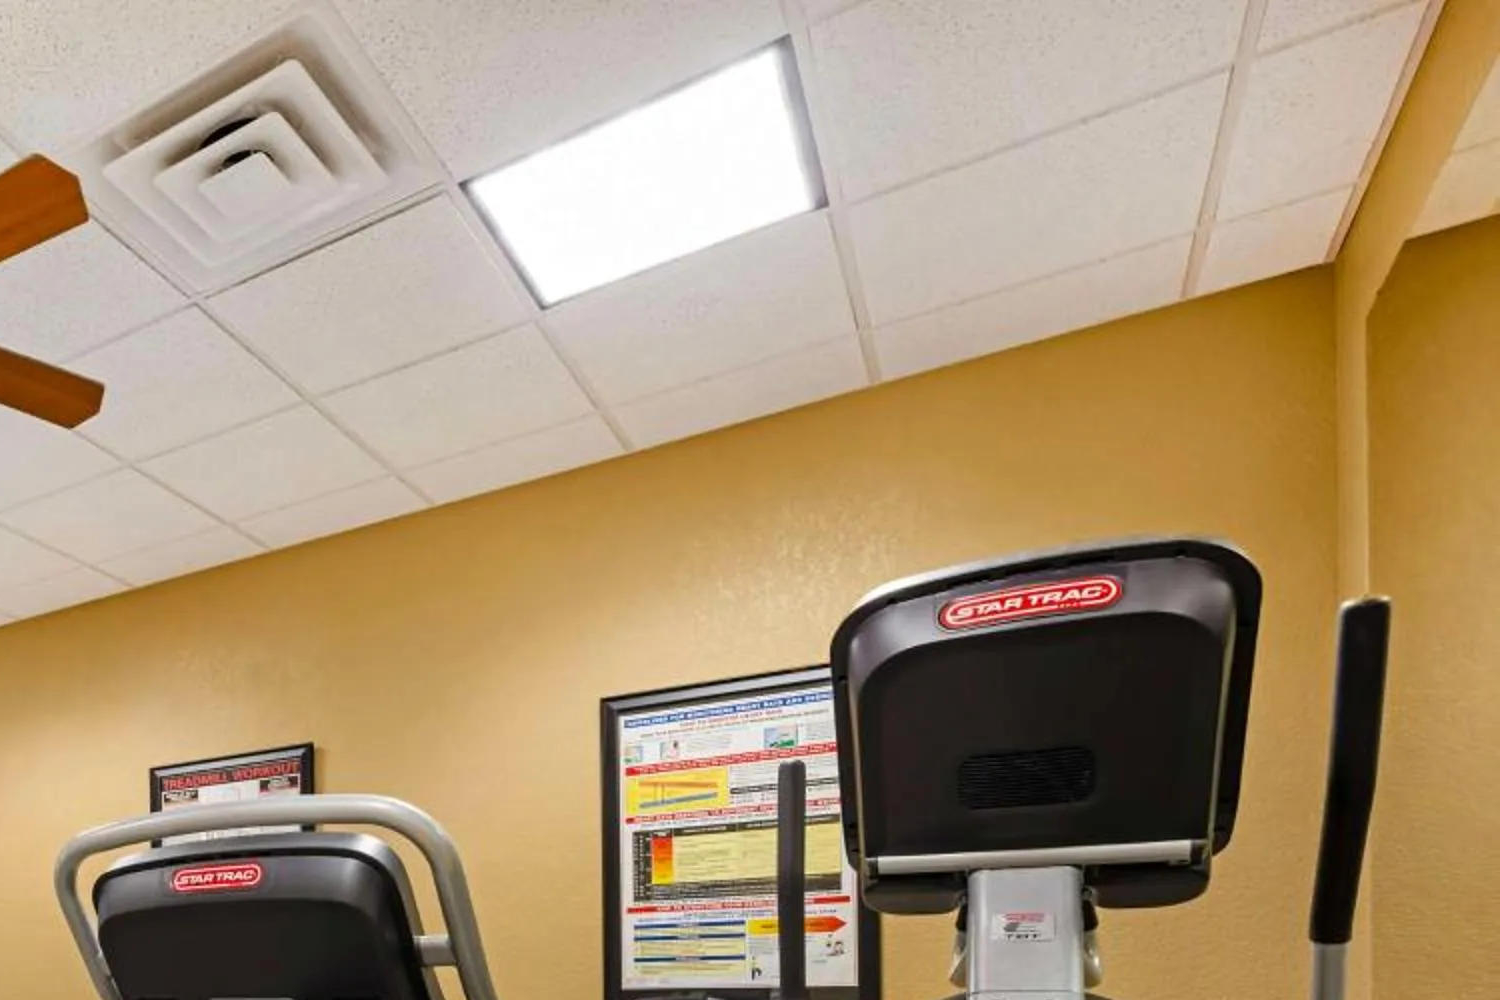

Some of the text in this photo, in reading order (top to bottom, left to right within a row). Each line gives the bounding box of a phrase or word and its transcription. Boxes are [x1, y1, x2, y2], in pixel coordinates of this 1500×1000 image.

[956, 595, 1022, 618] STAR
[1029, 586, 1102, 606] TRAC
[163, 759, 300, 791] TREADMILL WORKOUT
[179, 869, 253, 885] STAR TRAC
